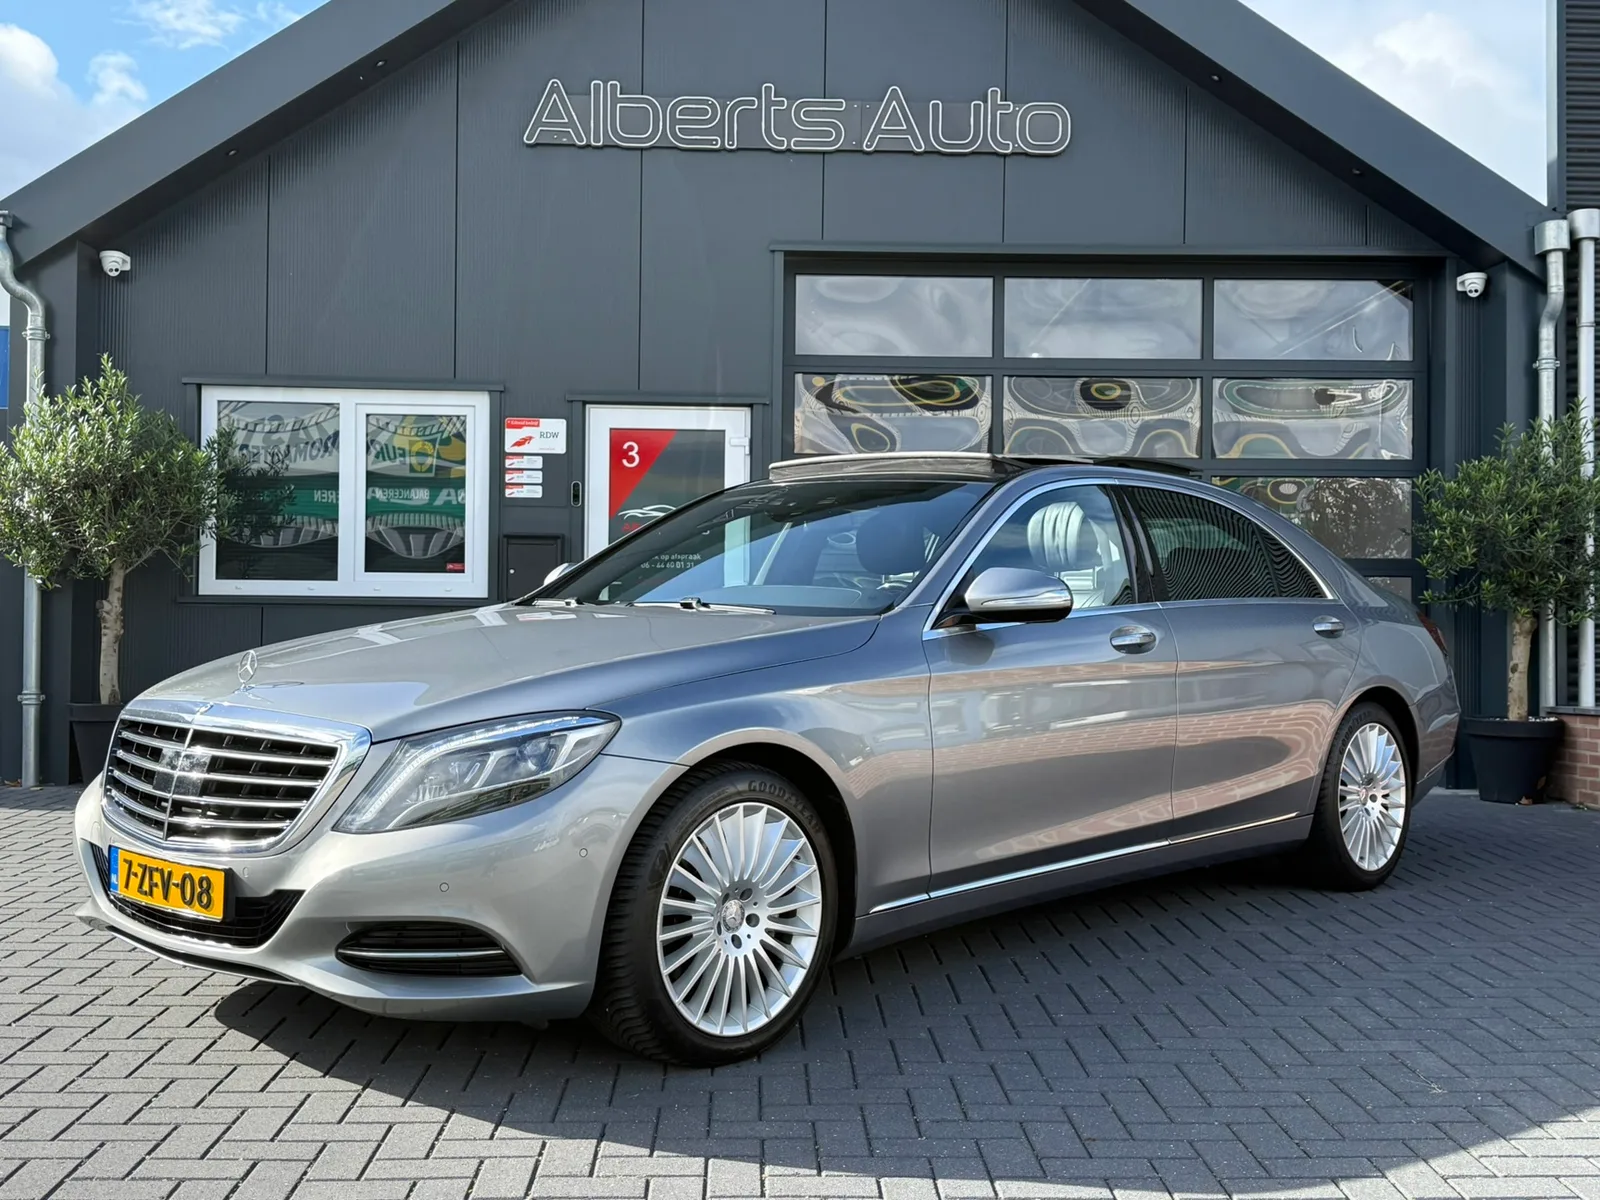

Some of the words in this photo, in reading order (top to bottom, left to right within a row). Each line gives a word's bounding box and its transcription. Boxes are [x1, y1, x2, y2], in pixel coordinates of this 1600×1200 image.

[523, 79, 846, 151] Alberts
[863, 86, 1072, 155] Auto
[539, 431, 560, 439] RDW
[622, 441, 640, 468] 3
[670, 553, 702, 561] afspraak
[123, 858, 214, 911] 7-ZFV-08
